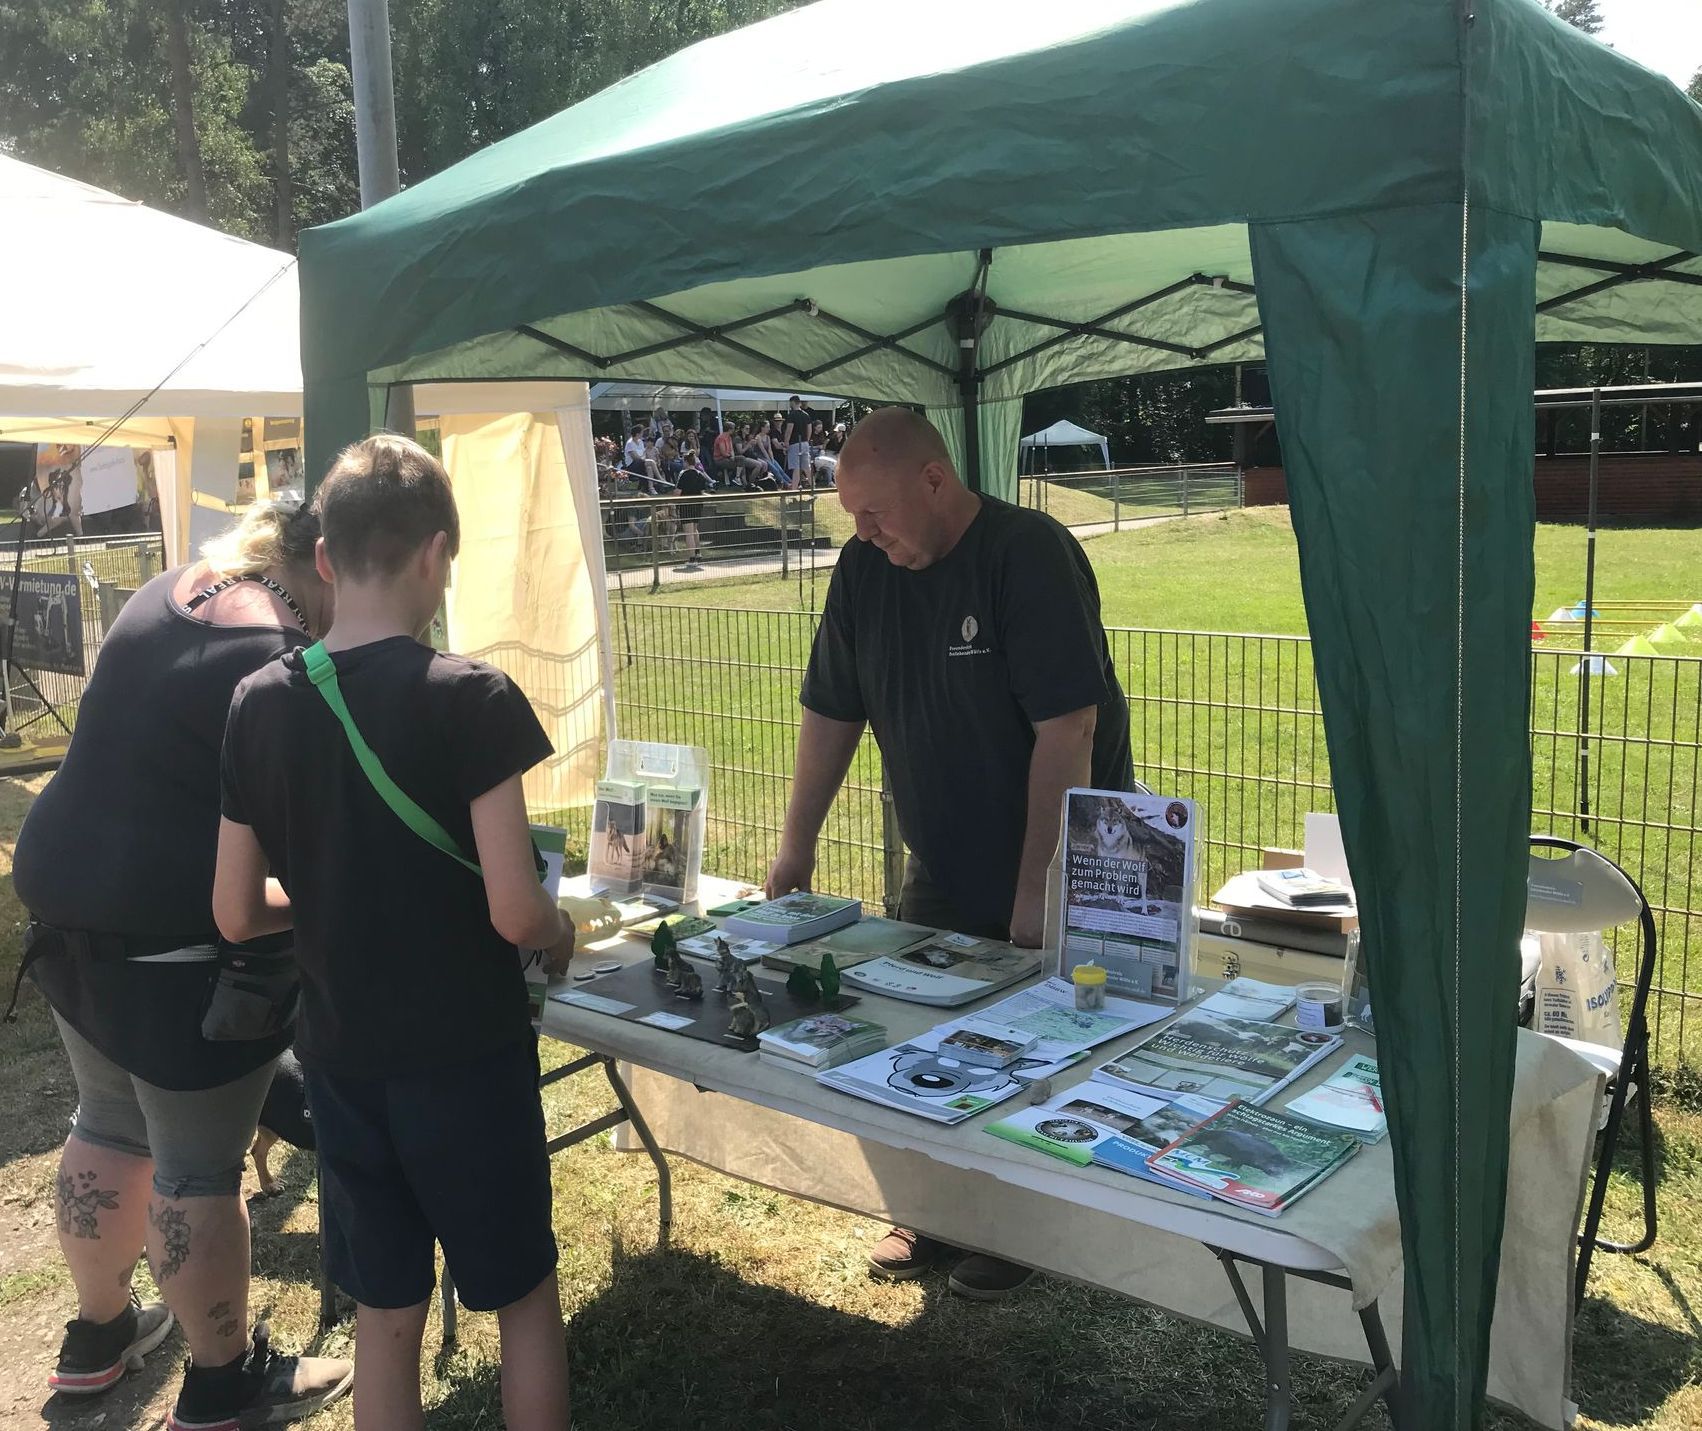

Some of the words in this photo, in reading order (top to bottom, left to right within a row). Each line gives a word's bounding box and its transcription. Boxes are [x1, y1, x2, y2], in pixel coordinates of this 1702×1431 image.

[199, 576, 237, 598] REAL
[261, 576, 294, 604] REAL
[1072, 854, 1102, 867] Wenn
[1103, 858, 1120, 869] der
[1122, 860, 1147, 872] Wolf
[1071, 867, 1093, 878] zum
[1095, 868, 1137, 883] Problem
[1071, 880, 1116, 893] gemacht
[1116, 884, 1140, 896] wird
[882, 961, 906, 971] Pferd
[1151, 1043, 1176, 1053] und
[1178, 1049, 1245, 1066] Weidetiere
[1158, 1038, 1204, 1055] Wichtig
[1206, 1049, 1227, 1057] für
[1228, 1053, 1265, 1064] Wölfe
[1231, 1108, 1287, 1132] schlagstarkes
[1288, 1130, 1332, 1146] Argument
[1237, 1104, 1286, 1125] Elektrozaun
[1293, 1125, 1308, 1133] ein
